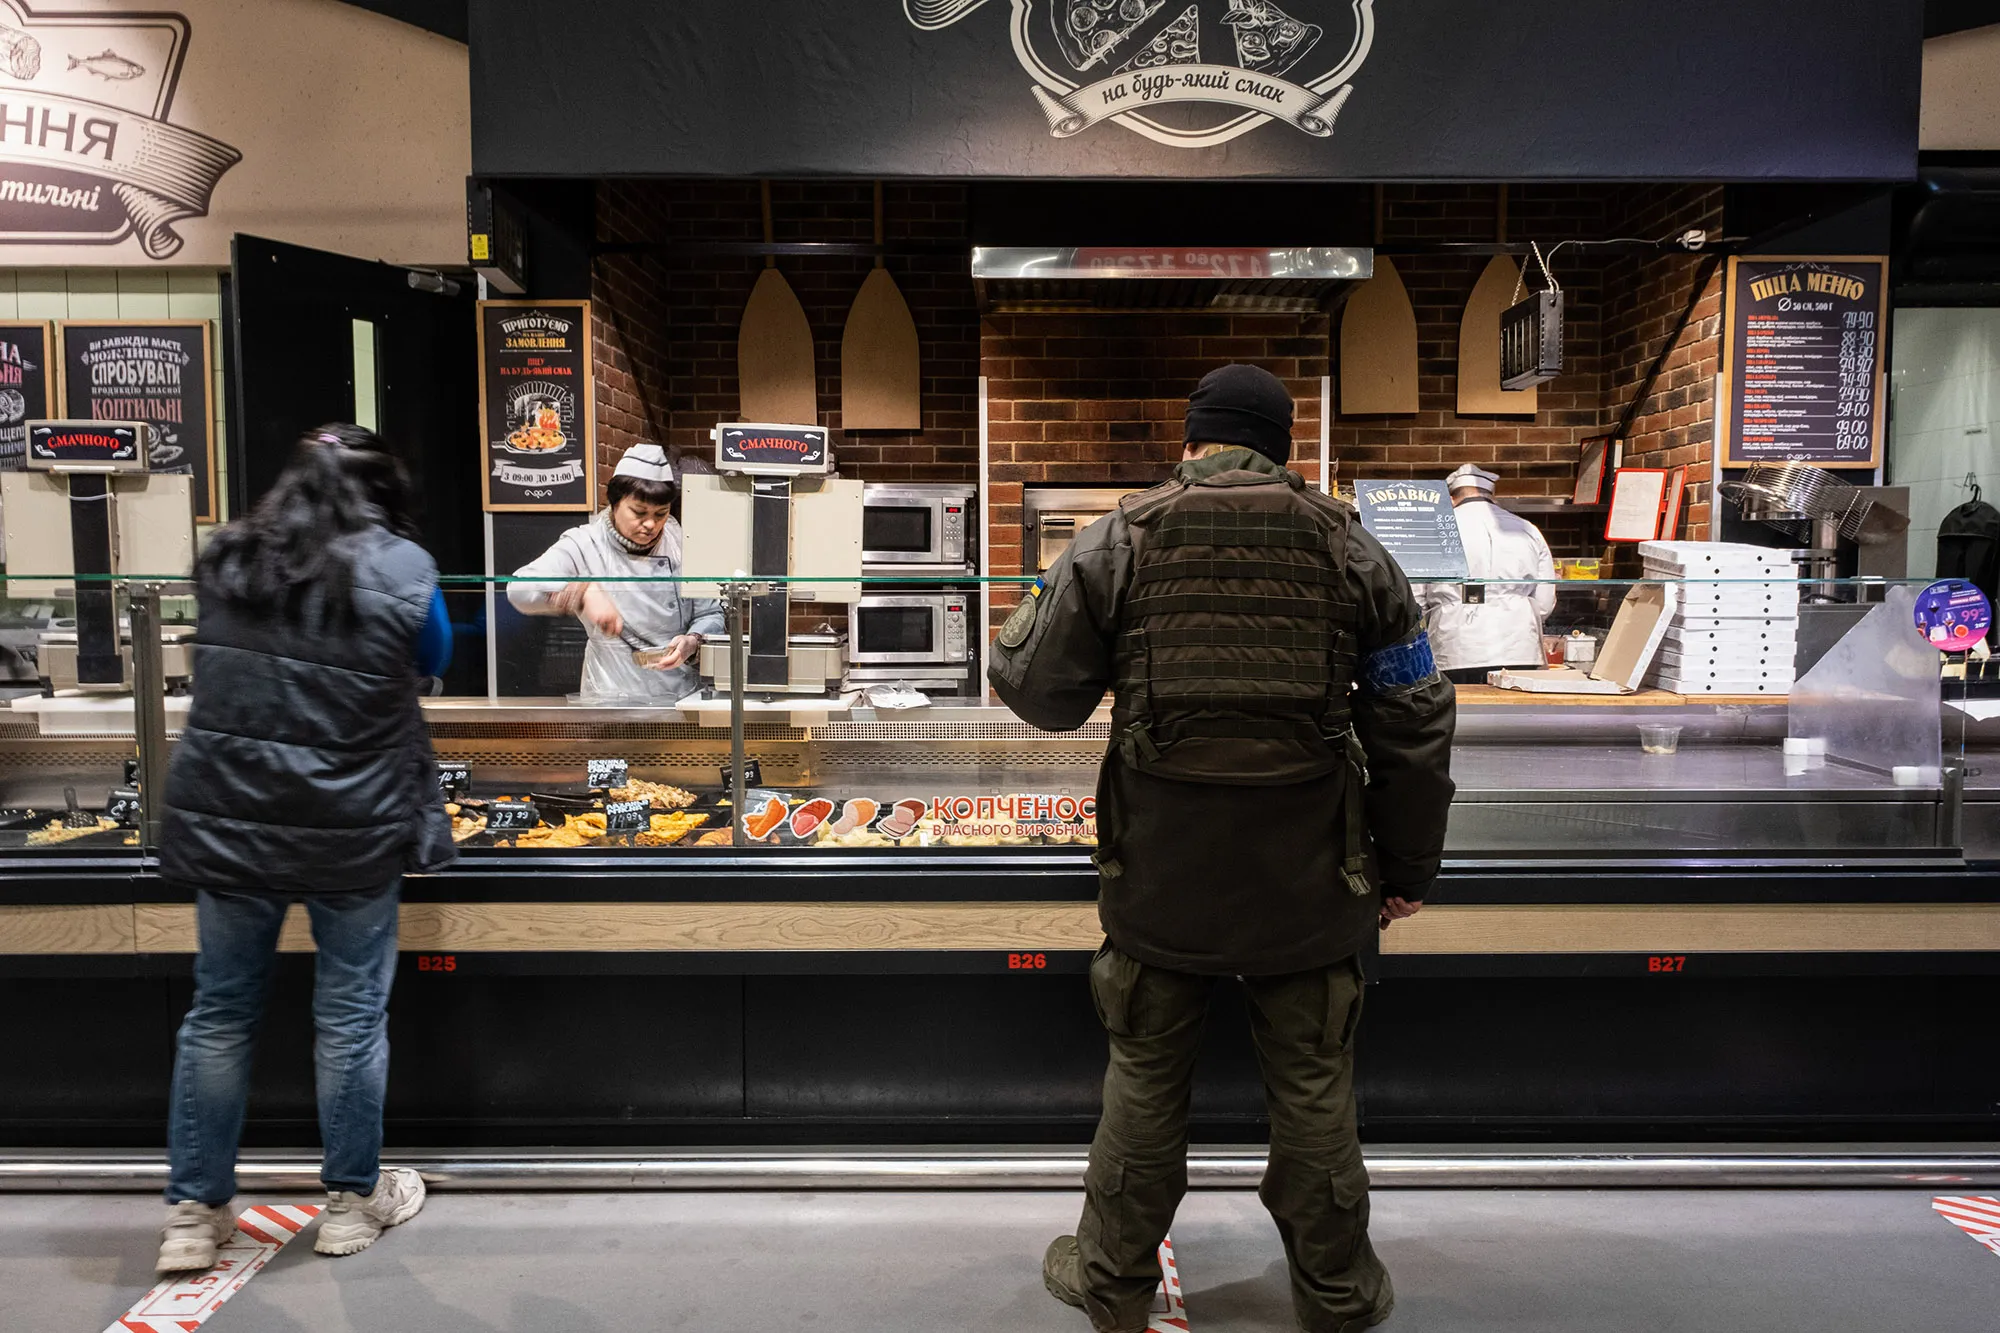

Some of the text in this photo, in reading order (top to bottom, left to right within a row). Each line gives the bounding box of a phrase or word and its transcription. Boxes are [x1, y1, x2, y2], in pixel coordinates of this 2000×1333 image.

[1102, 70, 1286, 105] на будь-який смак
[1750, 272, 1865, 302] ПІЦА МЕНЮ
[502, 318, 569, 333] ПРИГОТУЄМО
[102, 336, 148, 349] ЗАВЖДИ
[506, 337, 566, 348] ЗАМОВЛЕННЯ
[92, 360, 180, 386] СПРОБУВАТИ
[91, 398, 183, 423] КОПТИЛЬНІ
[47, 434, 120, 450] СМАЧНОГО
[739, 438, 809, 453] СМАЧНОГО
[1365, 488, 1441, 506] ДОБАВКИ
[933, 824, 1012, 836] ВЛАСНОГО
[418, 956, 457, 971] B25
[1008, 953, 1047, 969] B26
[1648, 956, 1686, 972] B27
